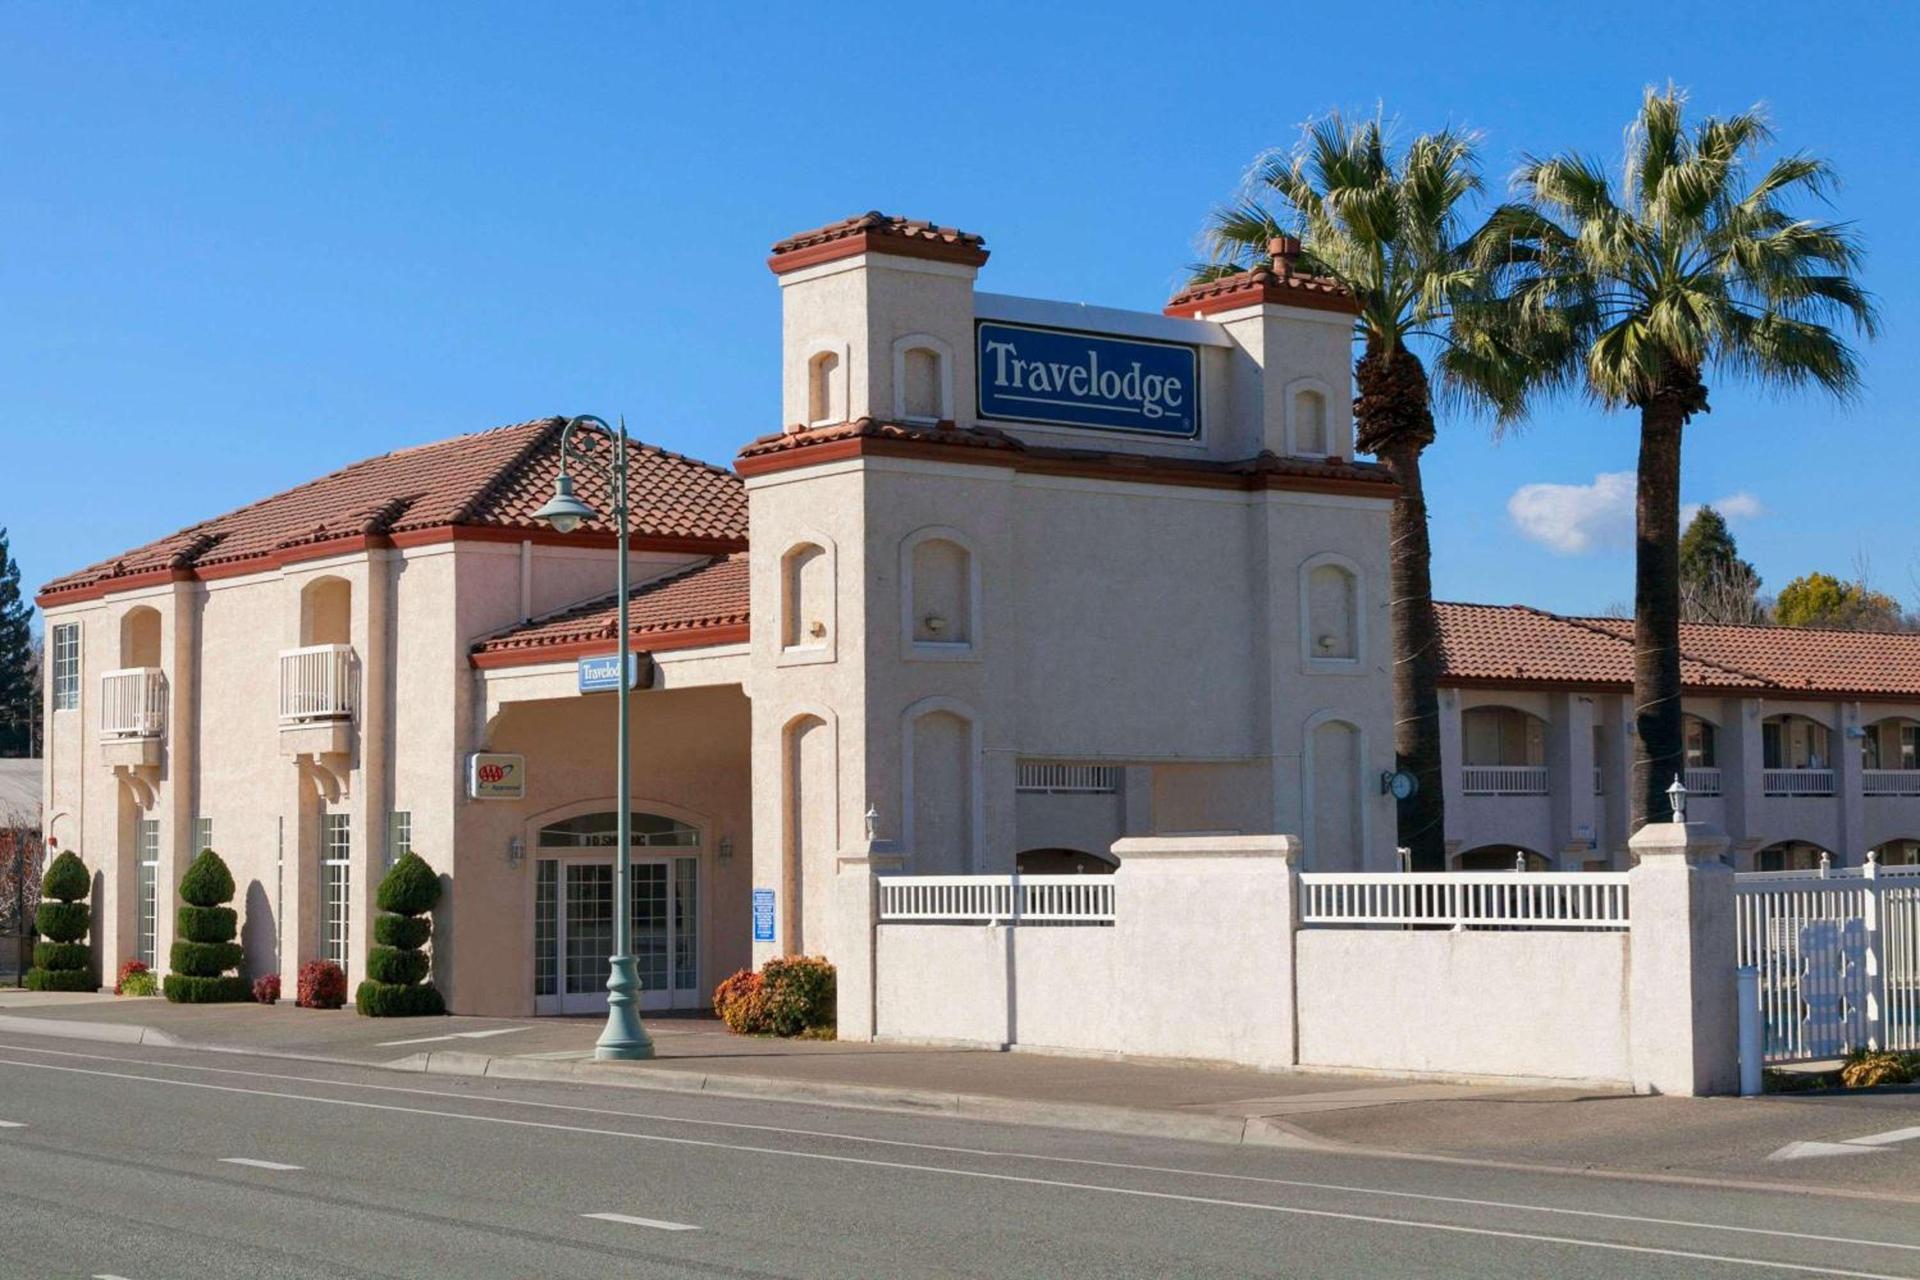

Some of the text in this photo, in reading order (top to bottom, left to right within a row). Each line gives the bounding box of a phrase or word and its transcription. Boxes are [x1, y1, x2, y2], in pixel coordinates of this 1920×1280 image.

[986, 340, 1182, 418] Travelodge
[583, 661, 622, 680] Travelod
[480, 765, 502, 781] AAA
